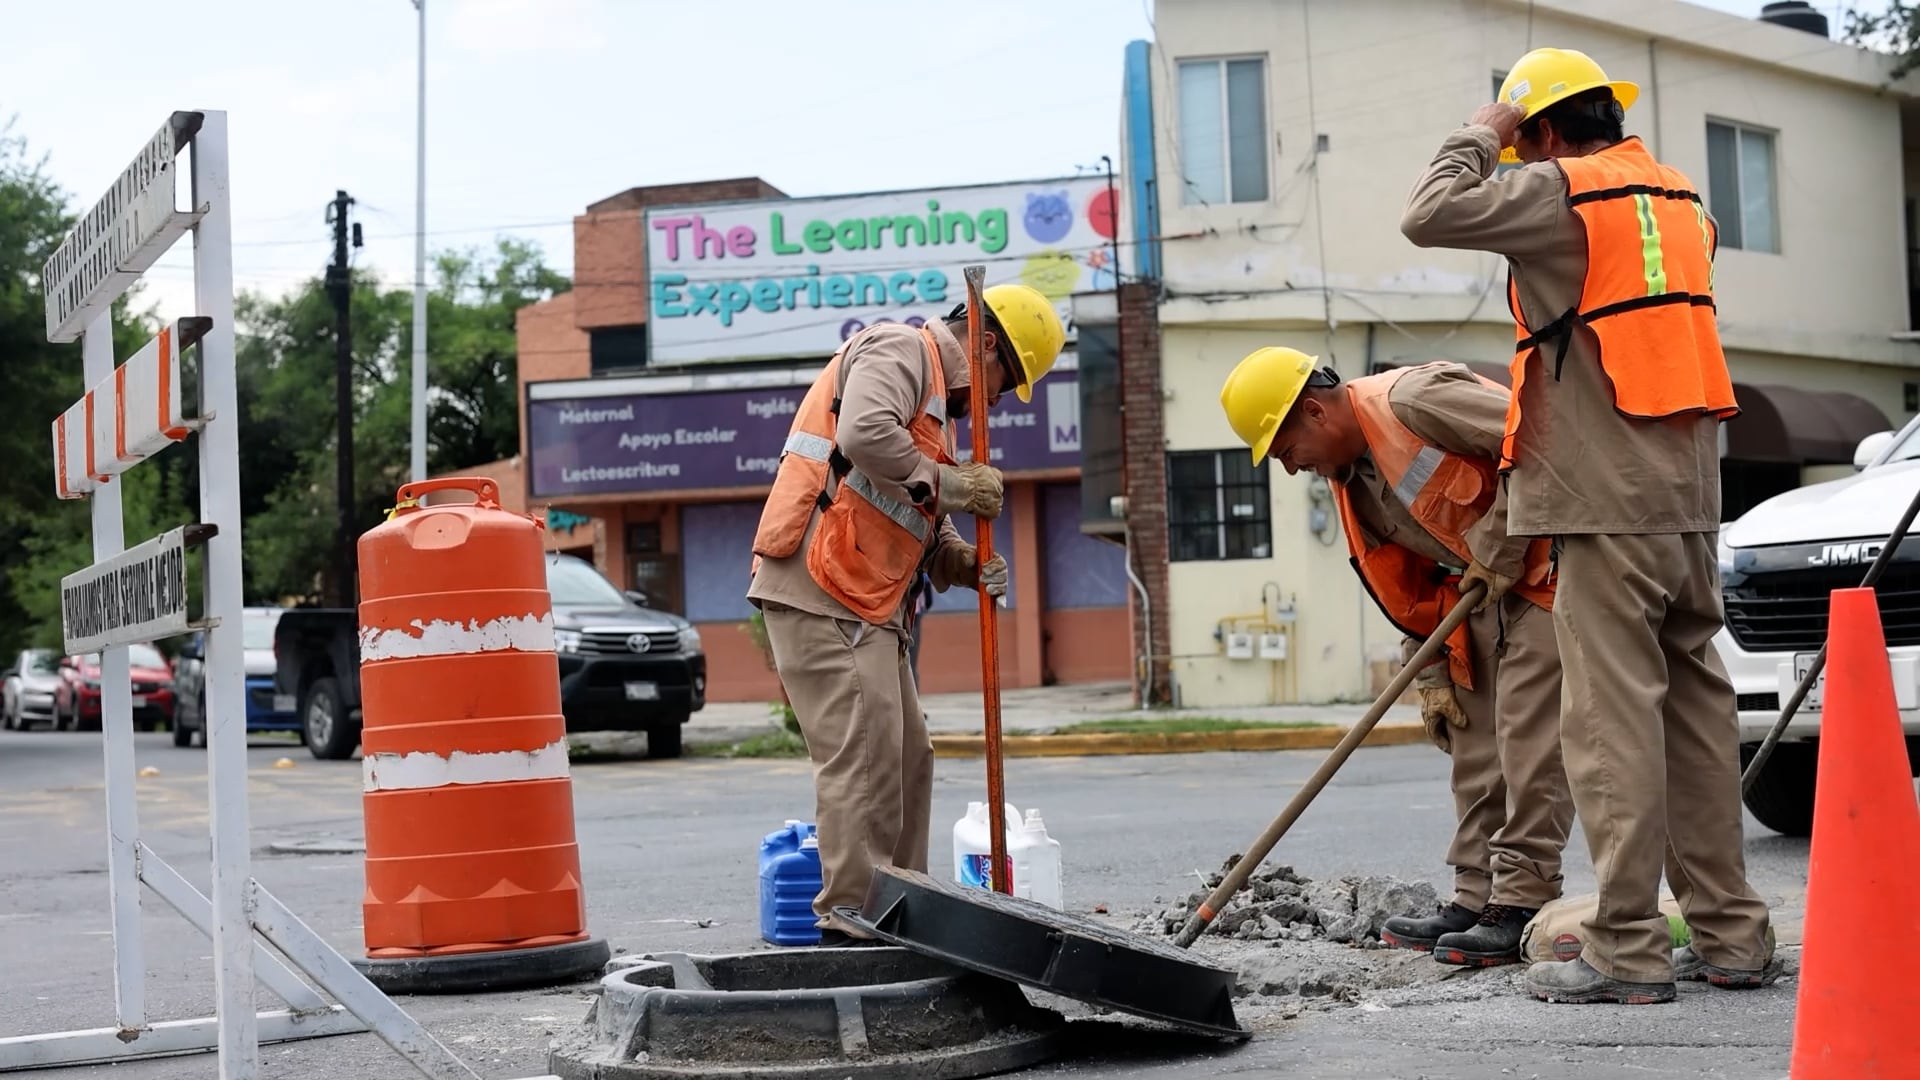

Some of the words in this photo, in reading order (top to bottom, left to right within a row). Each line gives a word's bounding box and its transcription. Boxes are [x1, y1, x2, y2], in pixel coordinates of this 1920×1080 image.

[652, 214, 756, 260] The
[770, 200, 1010, 253] Learning
[653, 264, 948, 327] Experience
[559, 404, 634, 425] Maternal
[618, 431, 672, 451] Apoyo
[675, 427, 738, 445] Escolar
[561, 461, 681, 483] Lectoescritura
[1808, 542, 1887, 566] JMC
[102, 570, 121, 632] PARA
[121, 557, 155, 628] SERVIRLE
[155, 545, 184, 618] MEJOR
